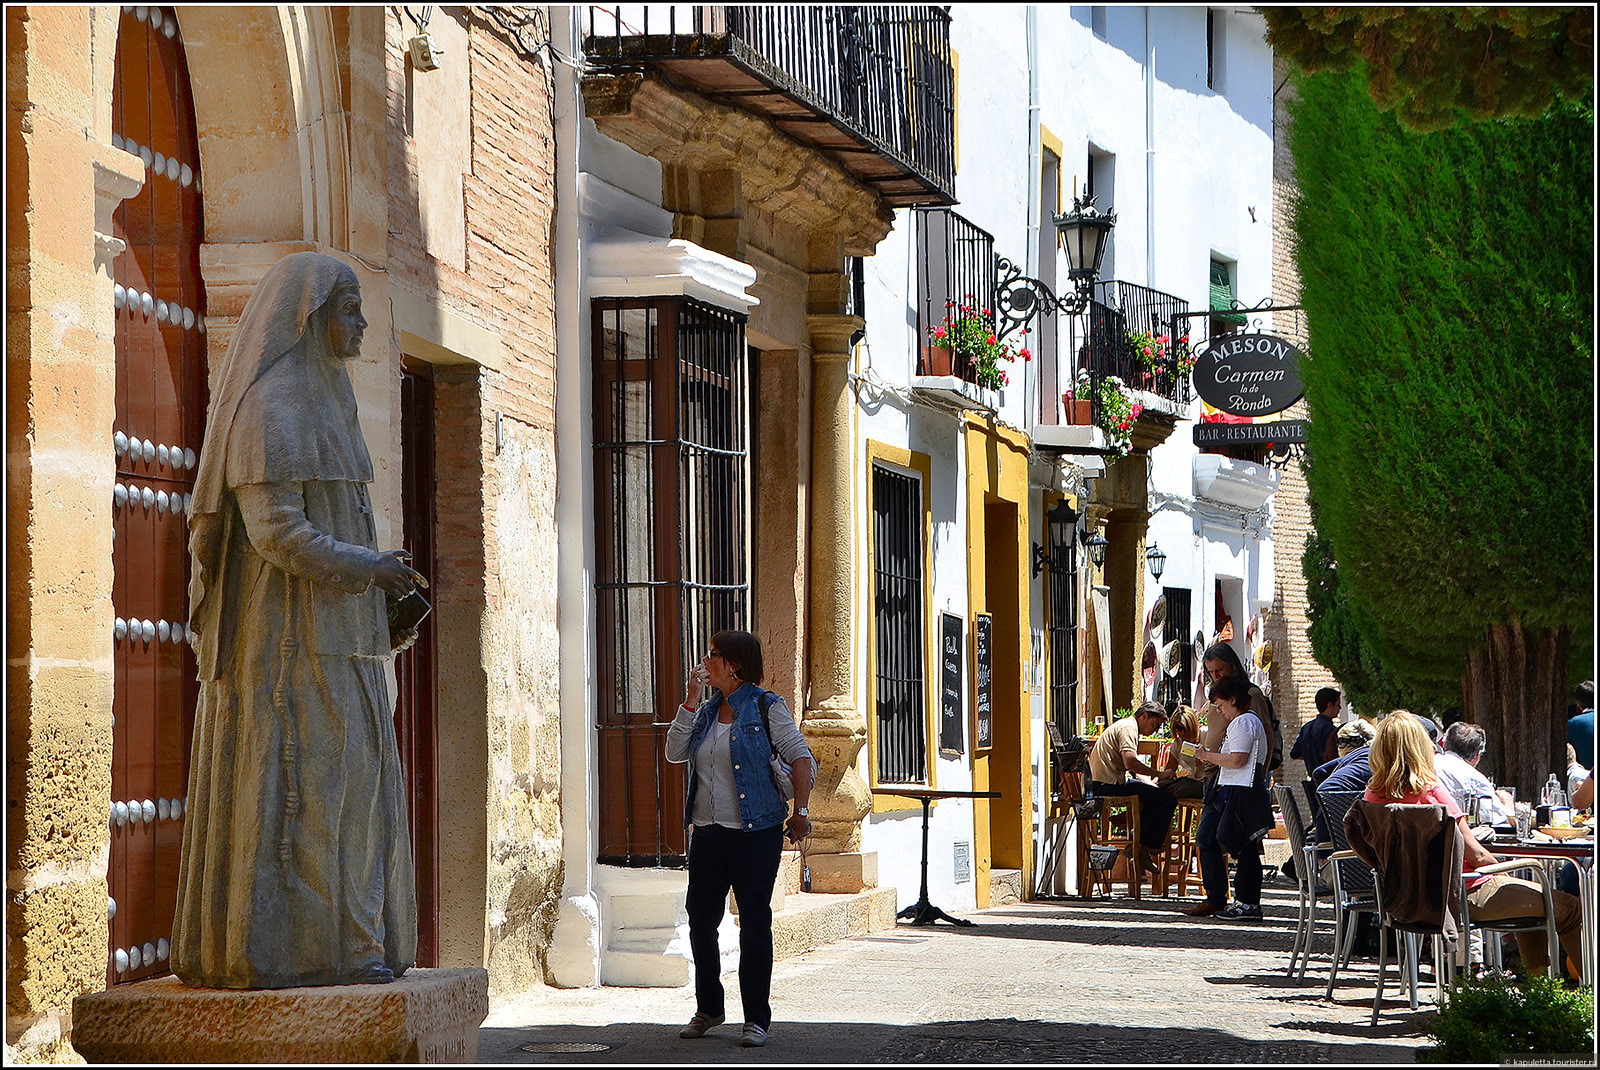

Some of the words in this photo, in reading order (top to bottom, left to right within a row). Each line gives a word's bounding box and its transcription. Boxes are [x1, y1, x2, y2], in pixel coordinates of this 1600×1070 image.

[1210, 338, 1290, 363] MESON
[1214, 364, 1285, 384] Carmen
[1240, 384, 1248, 393] la
[1249, 384, 1259, 393] de
[1228, 394, 1272, 411] Ronda
[1227, 424, 1303, 440] RESTAURANTE
